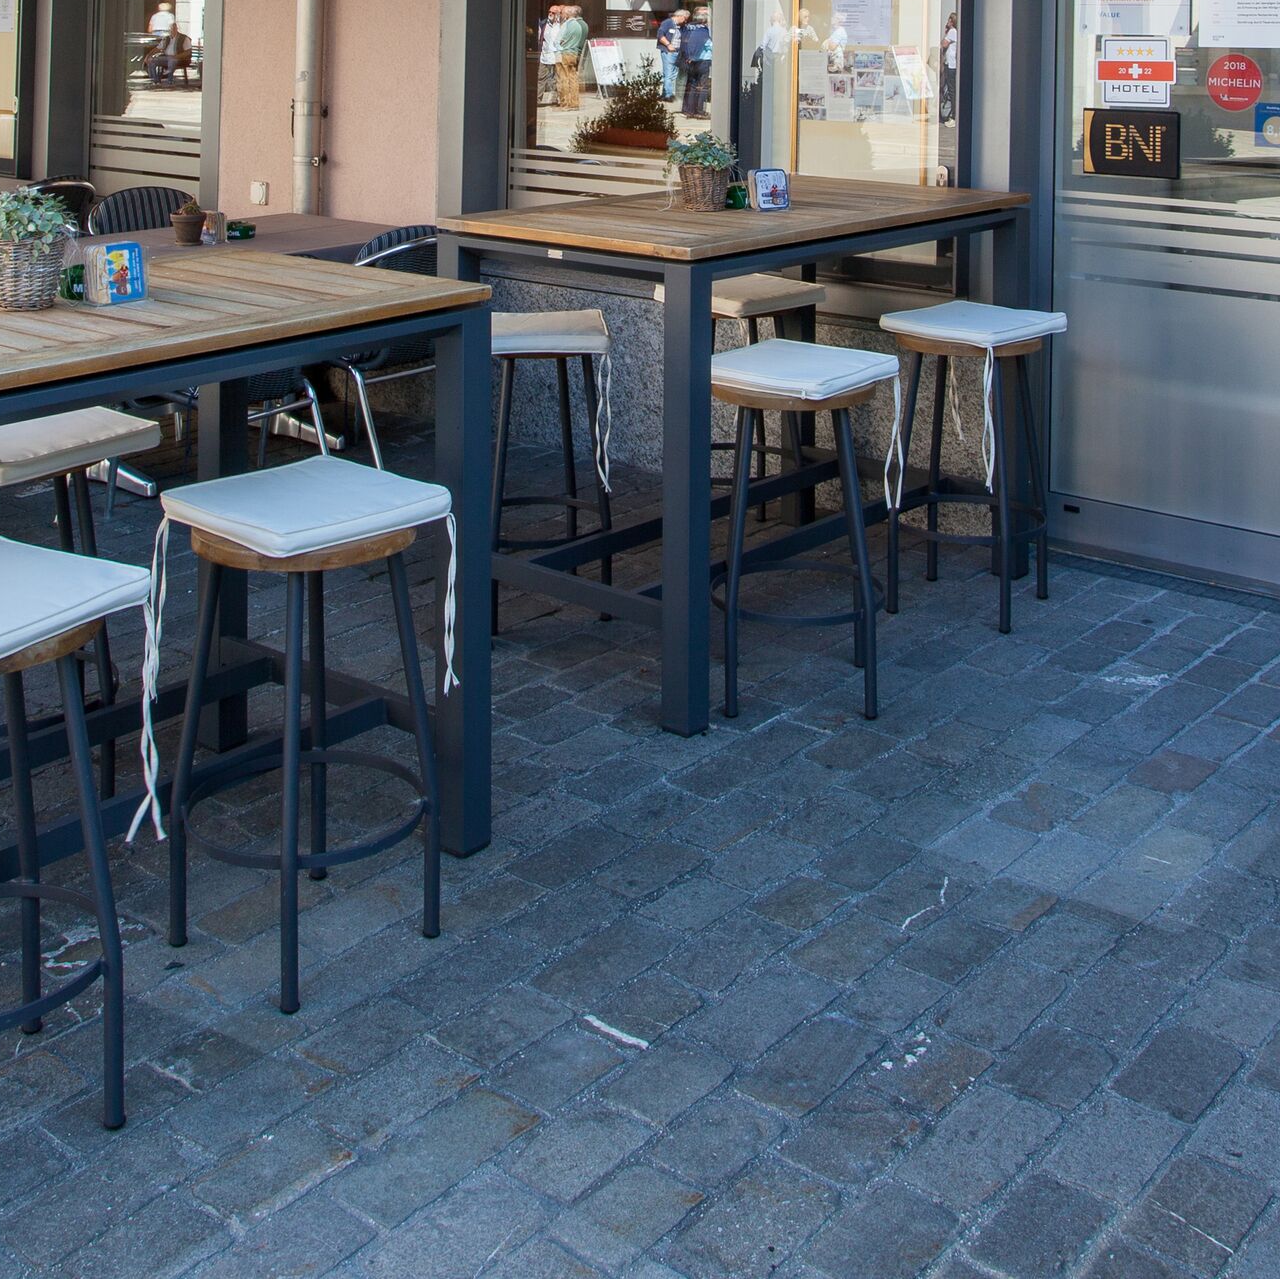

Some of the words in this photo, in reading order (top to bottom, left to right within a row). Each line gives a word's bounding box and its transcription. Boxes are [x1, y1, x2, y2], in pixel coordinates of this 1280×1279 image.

[1223, 61, 1246, 70] 2018
[1208, 77, 1261, 89] MICHELIN
[1112, 84, 1159, 93] HOTEL
